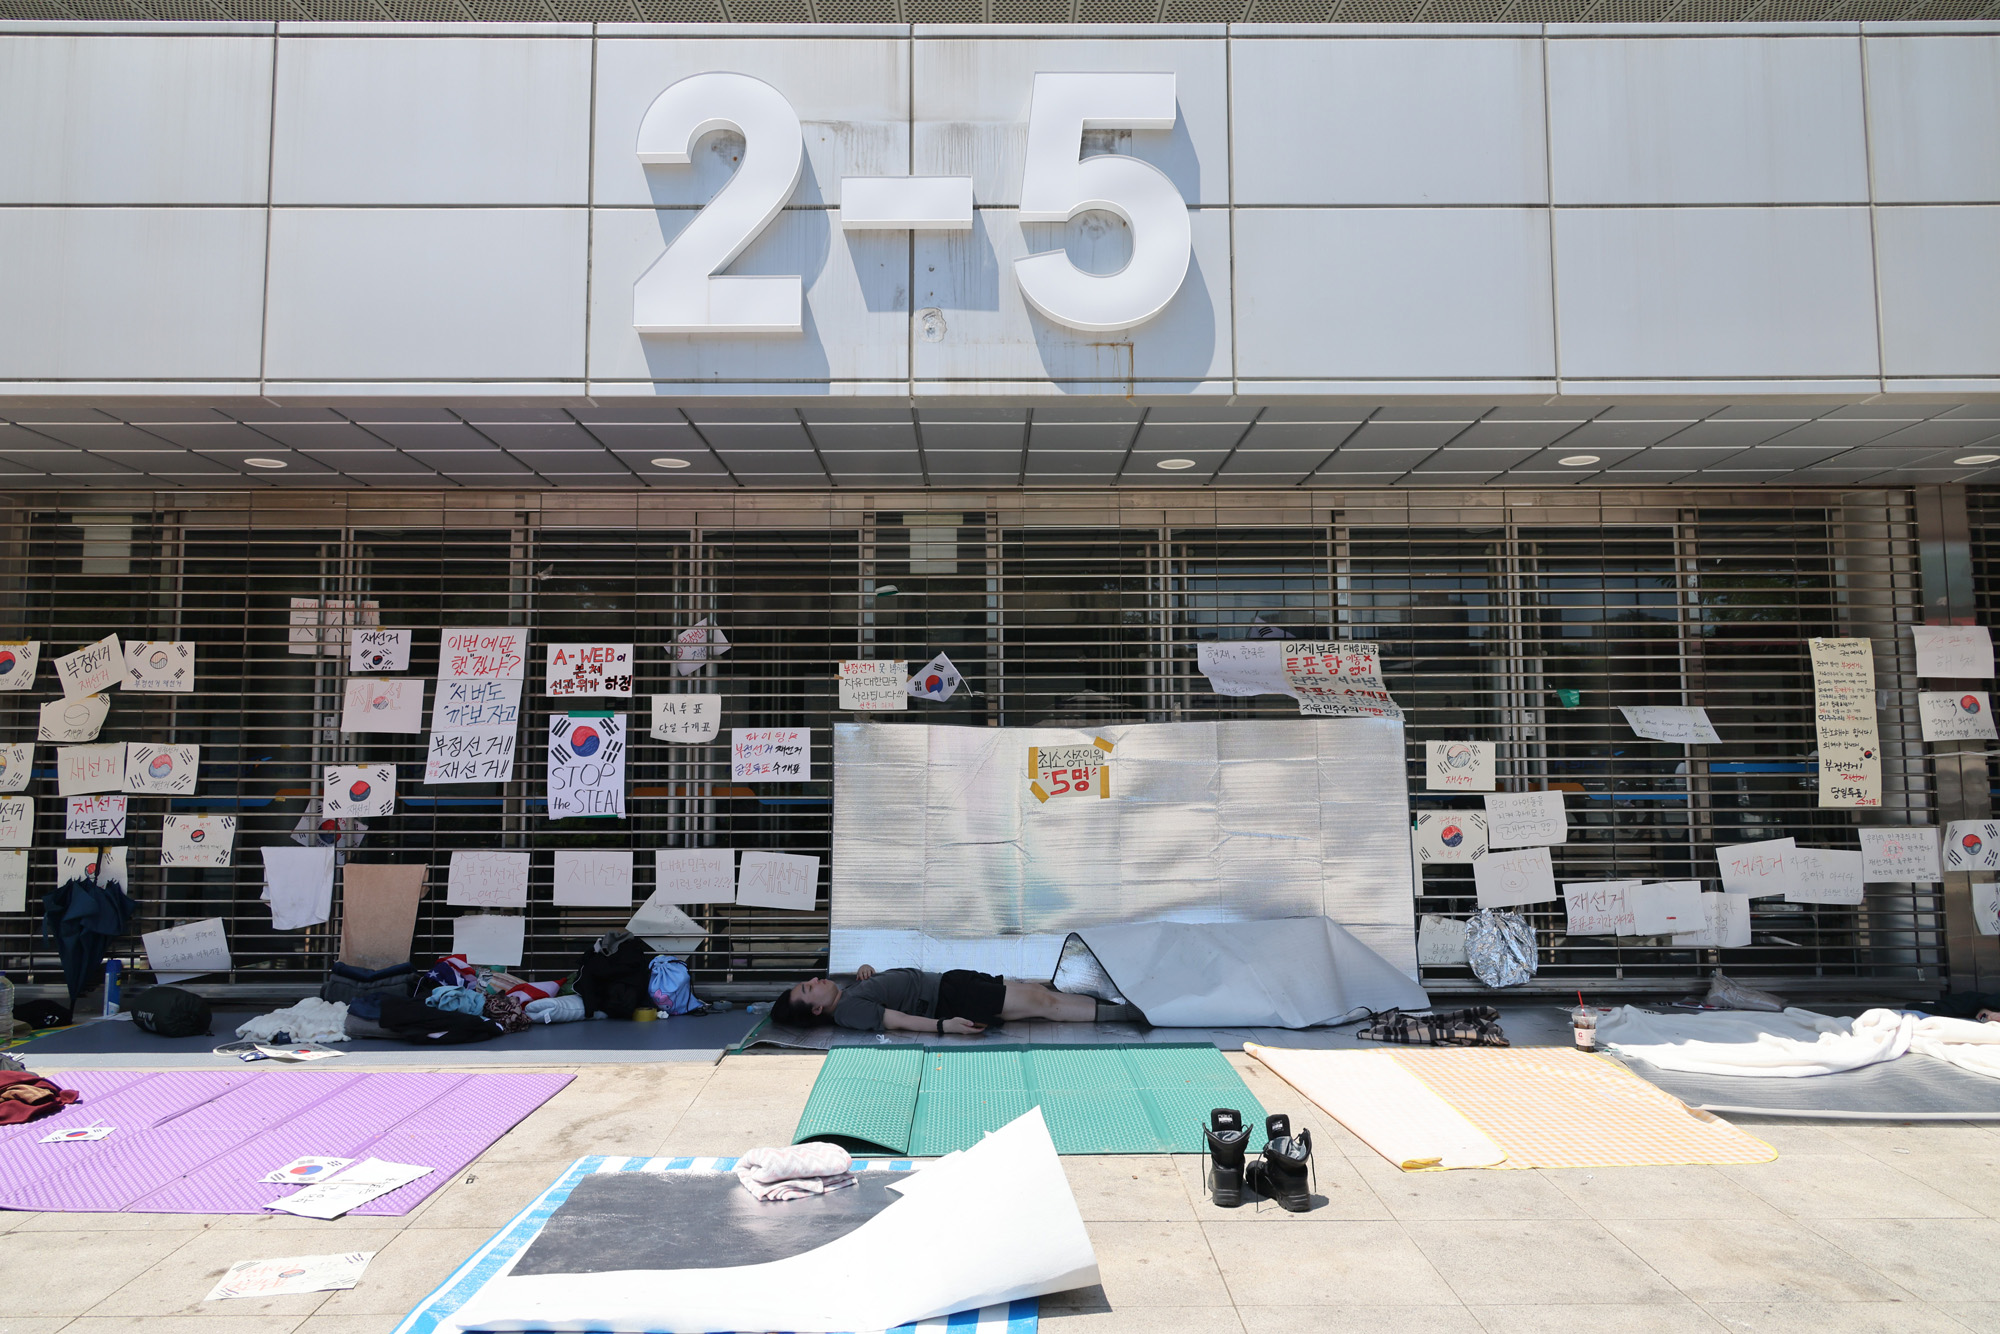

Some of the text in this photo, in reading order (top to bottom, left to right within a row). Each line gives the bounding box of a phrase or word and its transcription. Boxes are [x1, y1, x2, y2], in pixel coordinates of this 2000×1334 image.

[632, 70, 1192, 332] 2-5
[360, 632, 400, 647] 재선거
[1240, 645, 1266, 660] 한국은
[1285, 643, 1380, 658] 이제부터 대한민국
[65, 645, 111, 679] 부정선거
[843, 663, 876, 676] 부정선거
[1285, 655, 1342, 676] 투표함
[1348, 664, 1372, 676] 없이
[78, 669, 110, 692] 재선거
[550, 675, 633, 696] 선관위가 하청
[1351, 677, 1384, 690] 바로
[1343, 690, 1389, 704] 수개표
[659, 722, 712, 734] 당일 수개표
[1820, 726, 1873, 739] 분노해야 합니다!
[735, 743, 803, 759] 부정선거 재선거
[1038, 748, 1104, 769] 최소 상주인원
[64, 755, 116, 781] 재선거
[772, 761, 801, 776] 수개표
[1824, 759, 1863, 773] 부정선거!
[551, 763, 616, 791] STOP
[1445, 775, 1473, 787] 재선거
[1830, 786, 1868, 800] 당일투표!
[72, 797, 127, 815] 재선거
[346, 801, 371, 817] 재선거
[553, 789, 624, 814] the STEAL
[1491, 795, 1543, 811] 우리 아이들을
[1500, 824, 1537, 837] 재선거
[1865, 833, 1885, 845] 우리의
[660, 858, 721, 873] 대한민국에
[1493, 854, 1551, 875] 재선거
[1731, 852, 1785, 878] 재선거
[1790, 856, 1822, 871] 자유는
[1868, 858, 1895, 868] 재선거를
[464, 861, 519, 885] 부정선거
[565, 858, 630, 887] 재선거
[747, 860, 809, 896] 재선거
[669, 878, 691, 891] 이런
[693, 877, 711, 891] 일이
[477, 888, 504, 900] out
[1568, 887, 1626, 913] 재선거
